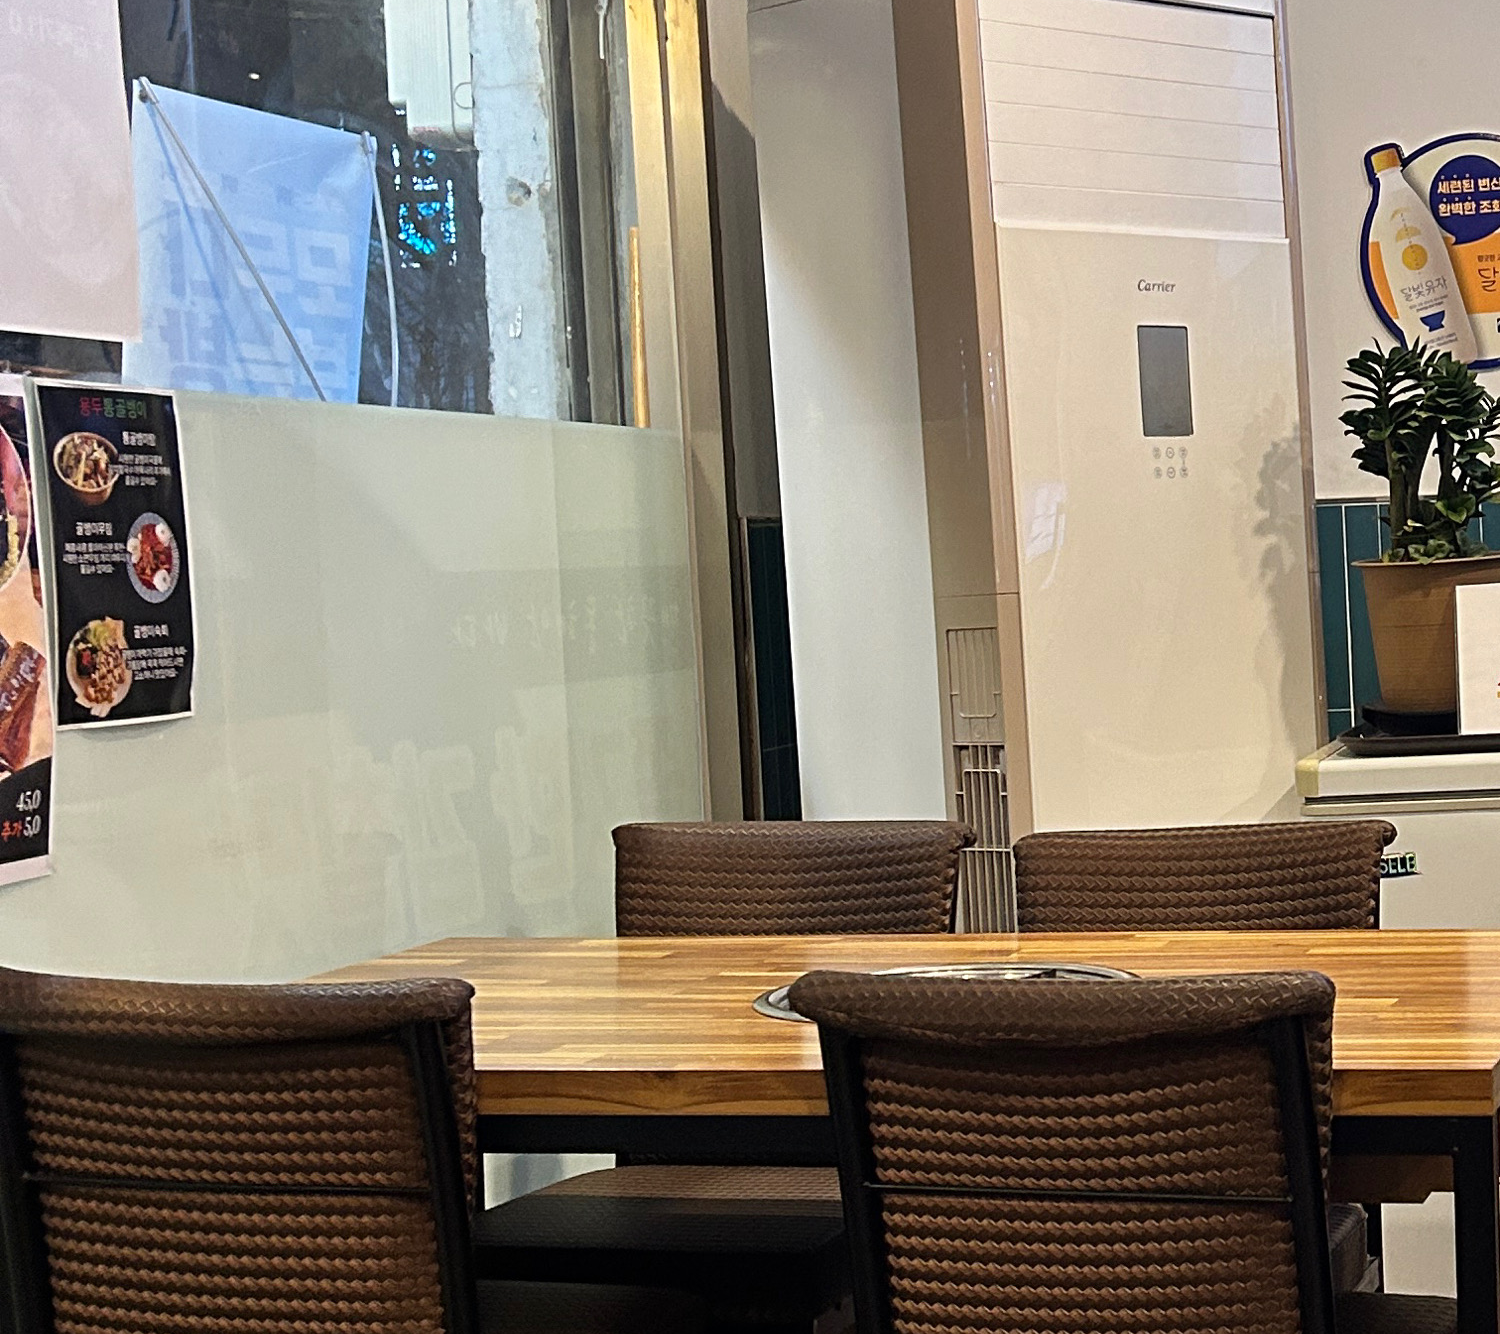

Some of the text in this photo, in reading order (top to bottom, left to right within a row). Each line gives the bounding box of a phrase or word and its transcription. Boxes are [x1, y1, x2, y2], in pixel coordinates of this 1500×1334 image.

[1437, 179, 1475, 194] 세련된
[1439, 201, 1476, 217] 완벽한
[1137, 278, 1176, 293] Carrier
[1401, 276, 1447, 302] 달빛유자
